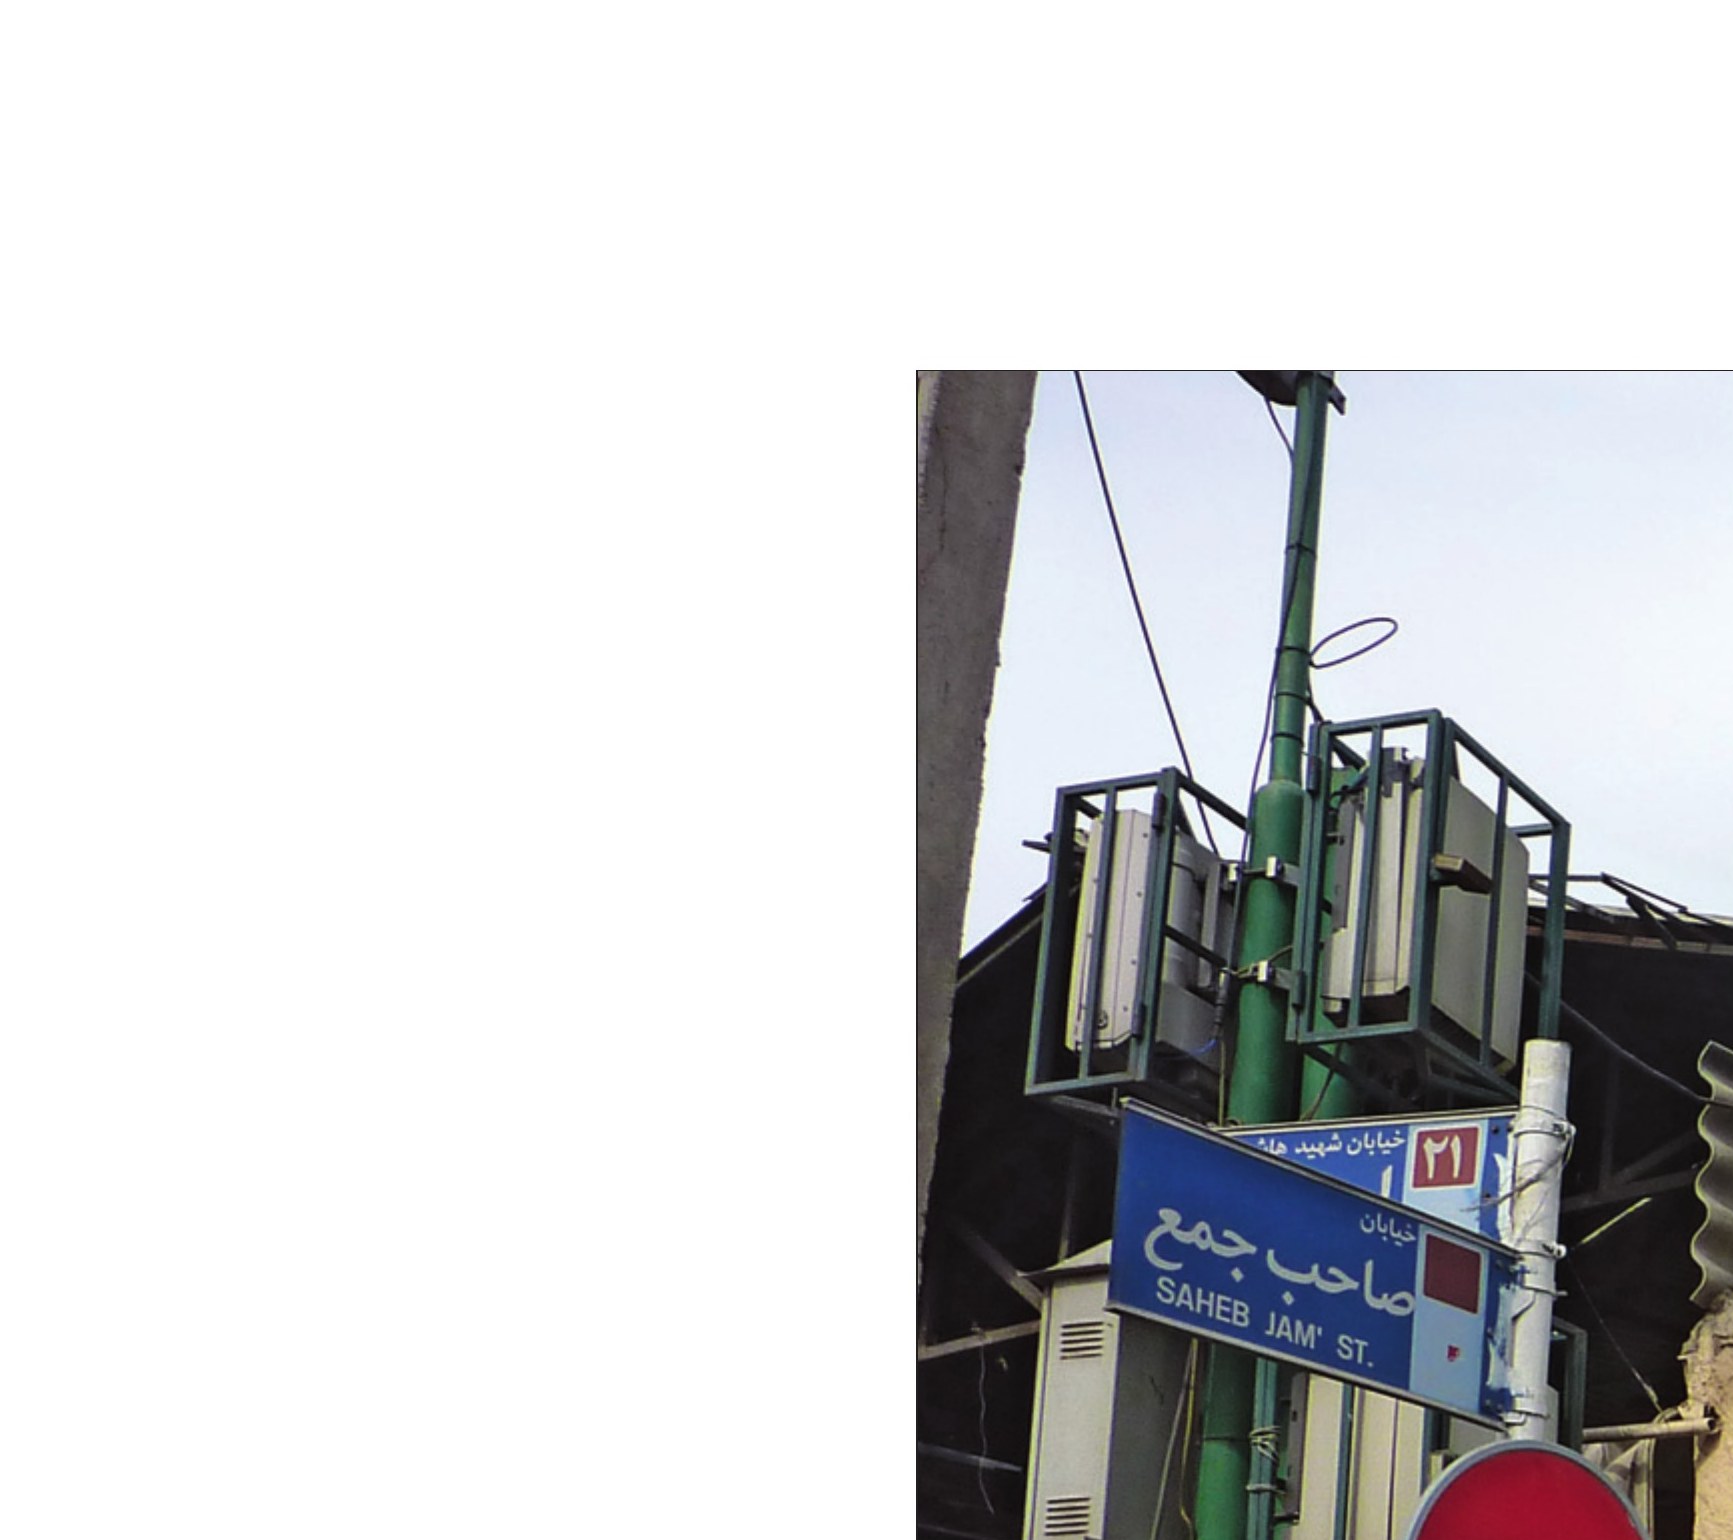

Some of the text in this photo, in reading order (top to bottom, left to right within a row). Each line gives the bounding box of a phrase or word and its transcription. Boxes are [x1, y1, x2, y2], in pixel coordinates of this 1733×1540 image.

[1294, 1131, 1343, 1160] شهید
[1346, 1128, 1407, 1156] خیابان
[1422, 1134, 1464, 1181] ۲۱
[1359, 1212, 1417, 1248] خیابان
[1143, 1207, 1416, 1317] صاحب جمع
[1155, 1275, 1375, 1368] SAHEB JAM' ST.
